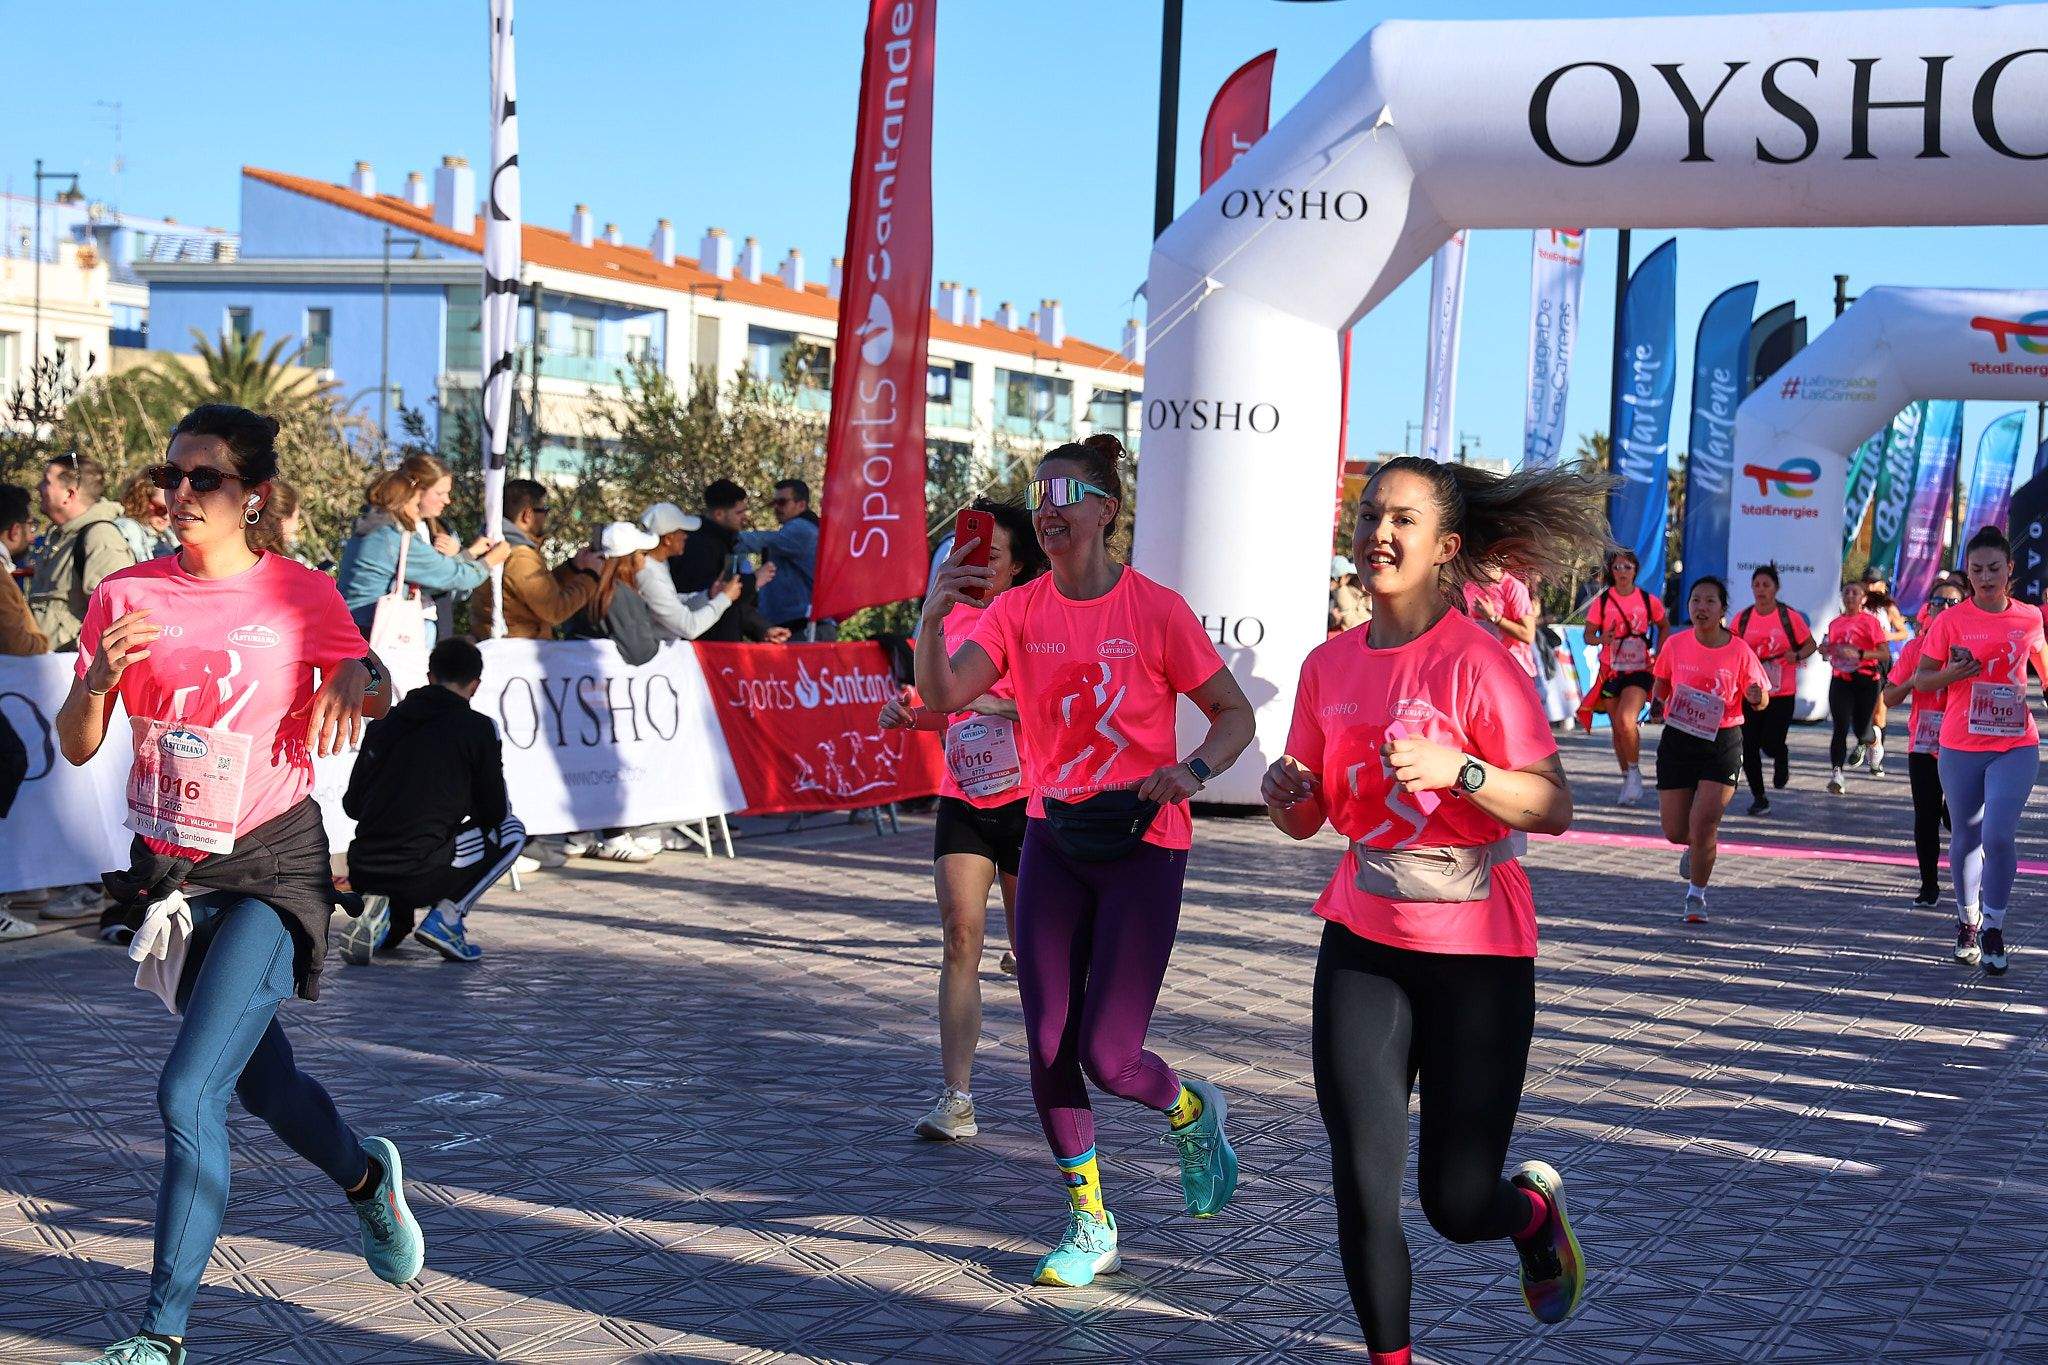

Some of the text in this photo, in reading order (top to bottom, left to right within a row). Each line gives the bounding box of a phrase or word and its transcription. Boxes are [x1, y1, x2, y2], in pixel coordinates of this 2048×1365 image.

[1528, 49, 2048, 167] OYSHO
[1221, 189, 1369, 223] OYSHO
[1147, 399, 1280, 434] OYSHO
[1618, 344, 1667, 483] Marlene
[1690, 367, 1737, 494] Marlene
[850, 380, 900, 558] Sports
[1025, 642, 1066, 654] OYSHO
[722, 666, 796, 718] Sports
[500, 674, 679, 750] OYSHO
[1991, 706, 2013, 716] 016
[162, 738, 203, 756] ASTURIANA
[965, 750, 993, 768] 016
[158, 774, 201, 801] 016
[164, 799, 182, 812] 2126
[180, 831, 218, 845] Santander
